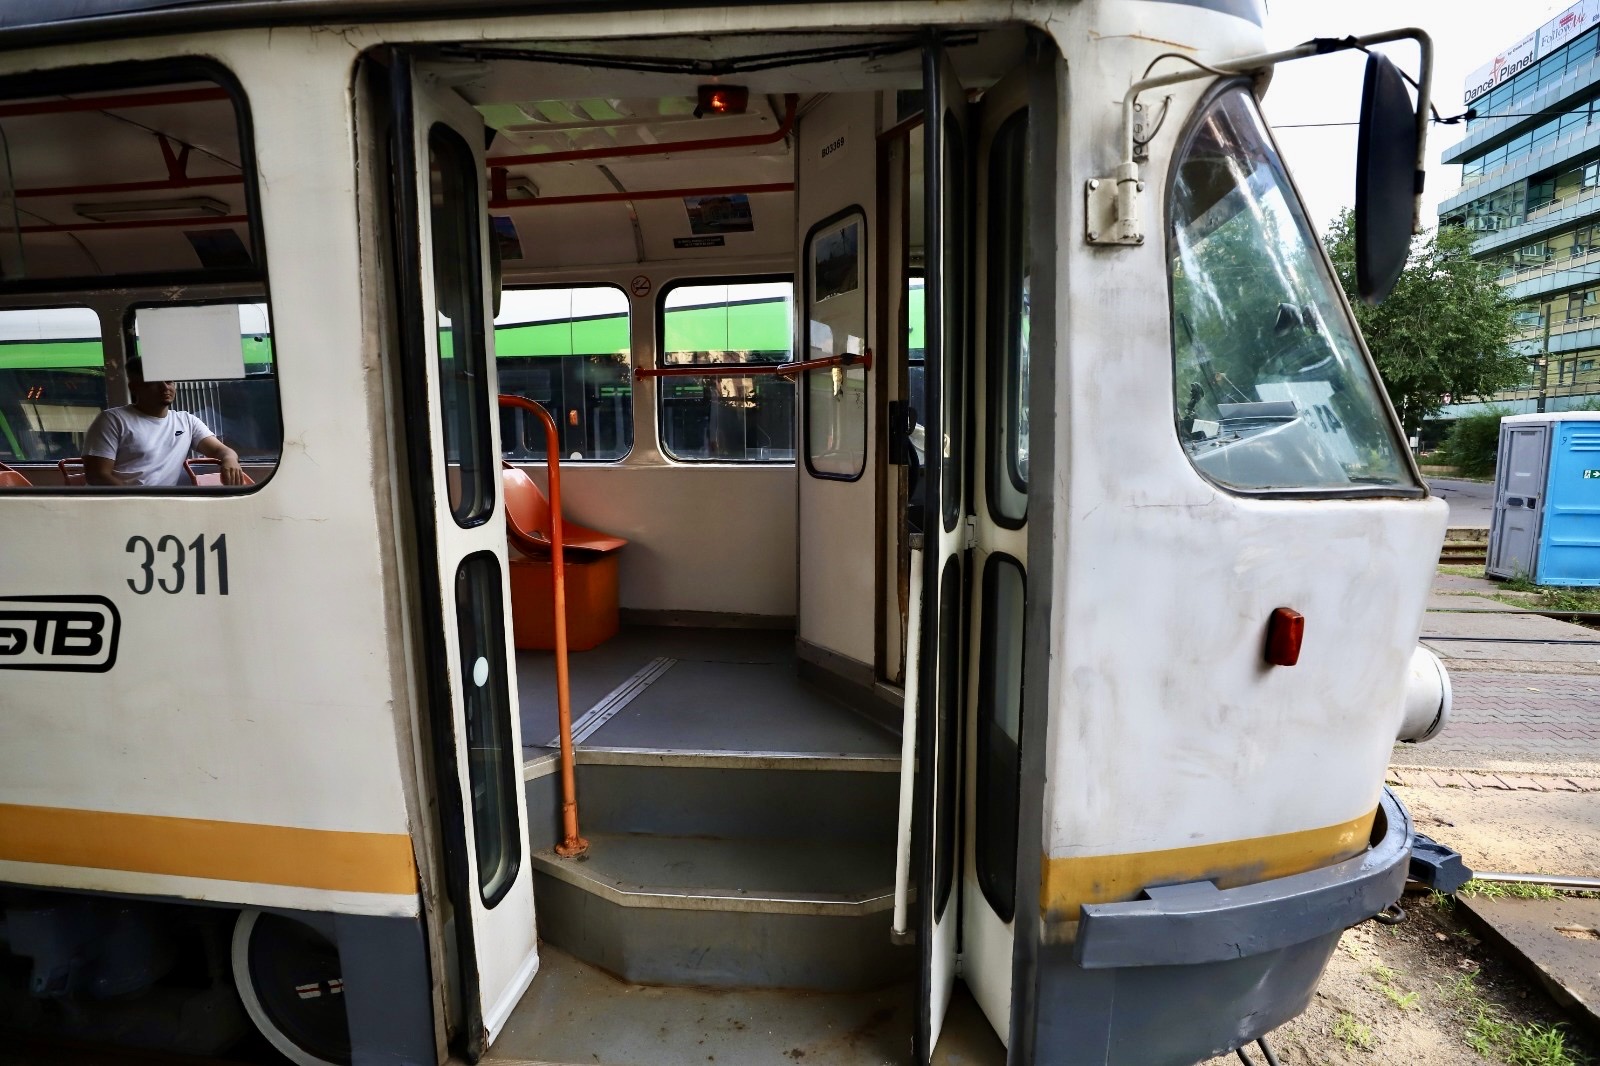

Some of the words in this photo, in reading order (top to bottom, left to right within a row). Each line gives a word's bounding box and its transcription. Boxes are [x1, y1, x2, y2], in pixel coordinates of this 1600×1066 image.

[1464, 78, 1494, 103] Dance
[1500, 50, 1534, 82] Planet
[125, 533, 229, 596] 3311
